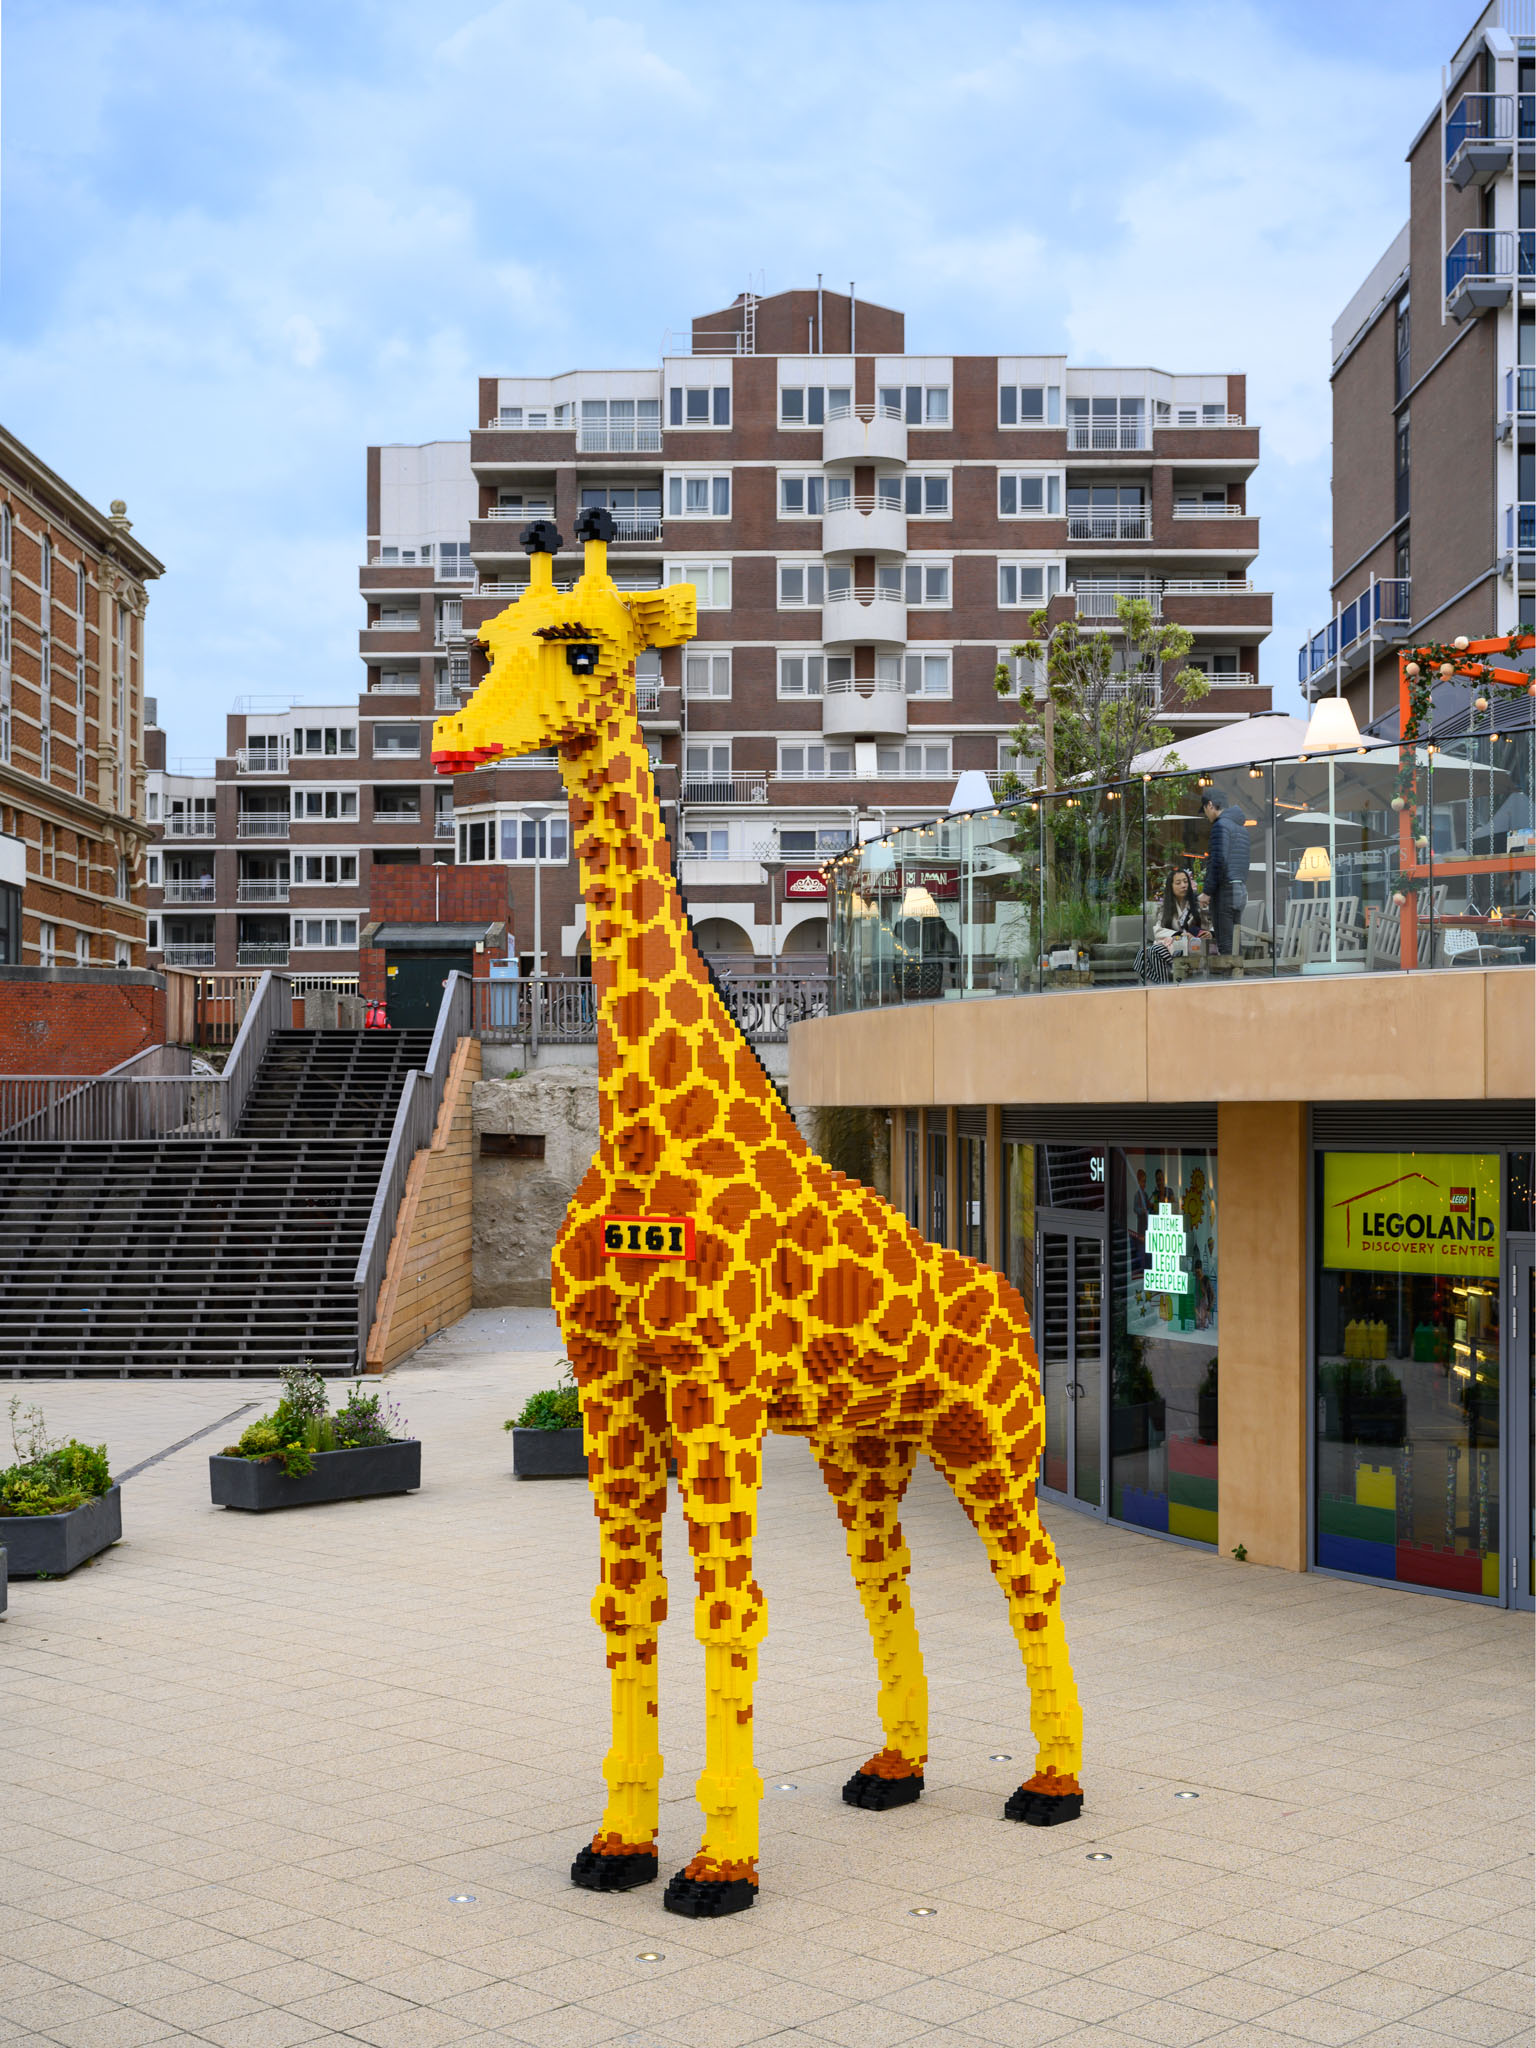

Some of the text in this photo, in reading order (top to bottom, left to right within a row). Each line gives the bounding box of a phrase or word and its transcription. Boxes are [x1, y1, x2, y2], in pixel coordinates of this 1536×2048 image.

[1451, 1194, 1469, 1205] LEGO
[1161, 1204, 1169, 1215] DE
[1152, 1216, 1180, 1232] ULTIEME
[1362, 1212, 1495, 1242] LEGOLAND
[604, 1224, 683, 1252] GIGI
[1148, 1232, 1185, 1254] INDOOR
[1361, 1240, 1496, 1258] DISCOVERY CENTRE
[1155, 1254, 1177, 1273] LEGO
[1145, 1271, 1187, 1292] SPEELPLEK
